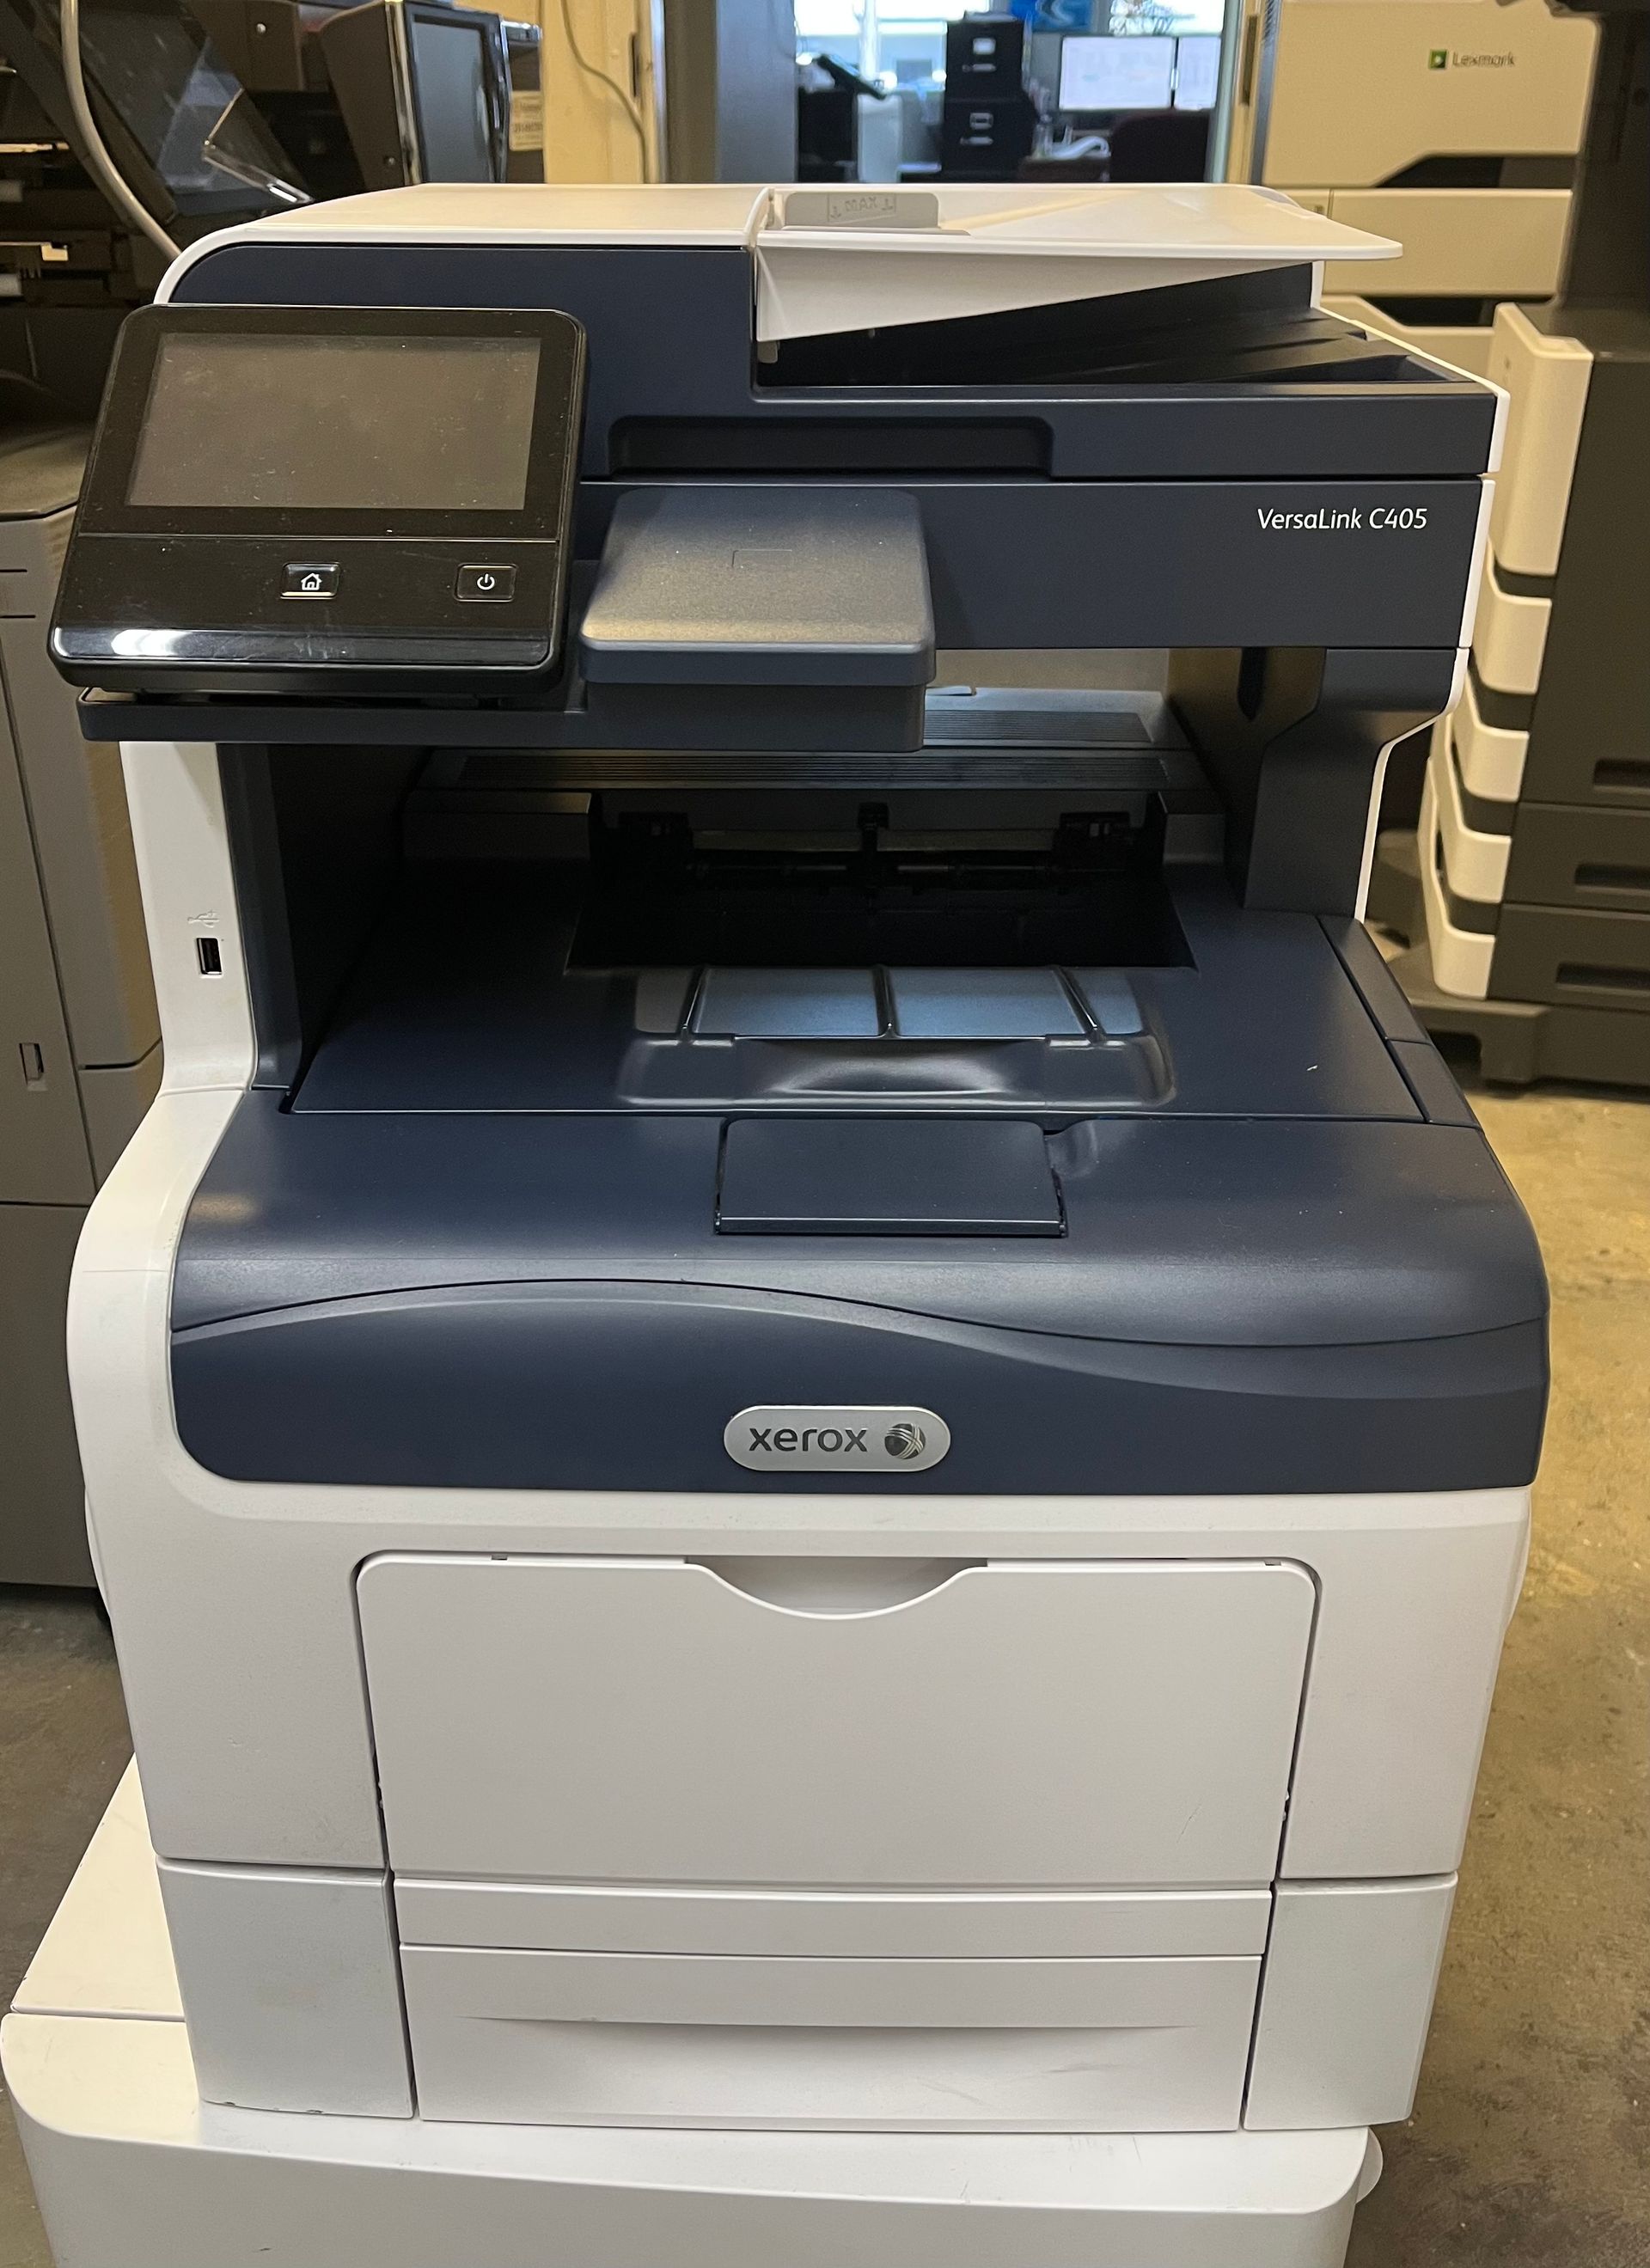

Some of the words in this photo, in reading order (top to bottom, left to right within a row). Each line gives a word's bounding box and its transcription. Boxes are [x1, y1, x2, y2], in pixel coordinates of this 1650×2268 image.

[1452, 52, 1515, 67] Lexmark
[845, 196, 877, 212] MAX
[1257, 508, 1362, 529] VersaLink
[1369, 508, 1427, 529] C405
[749, 1427, 869, 1452] xerox
